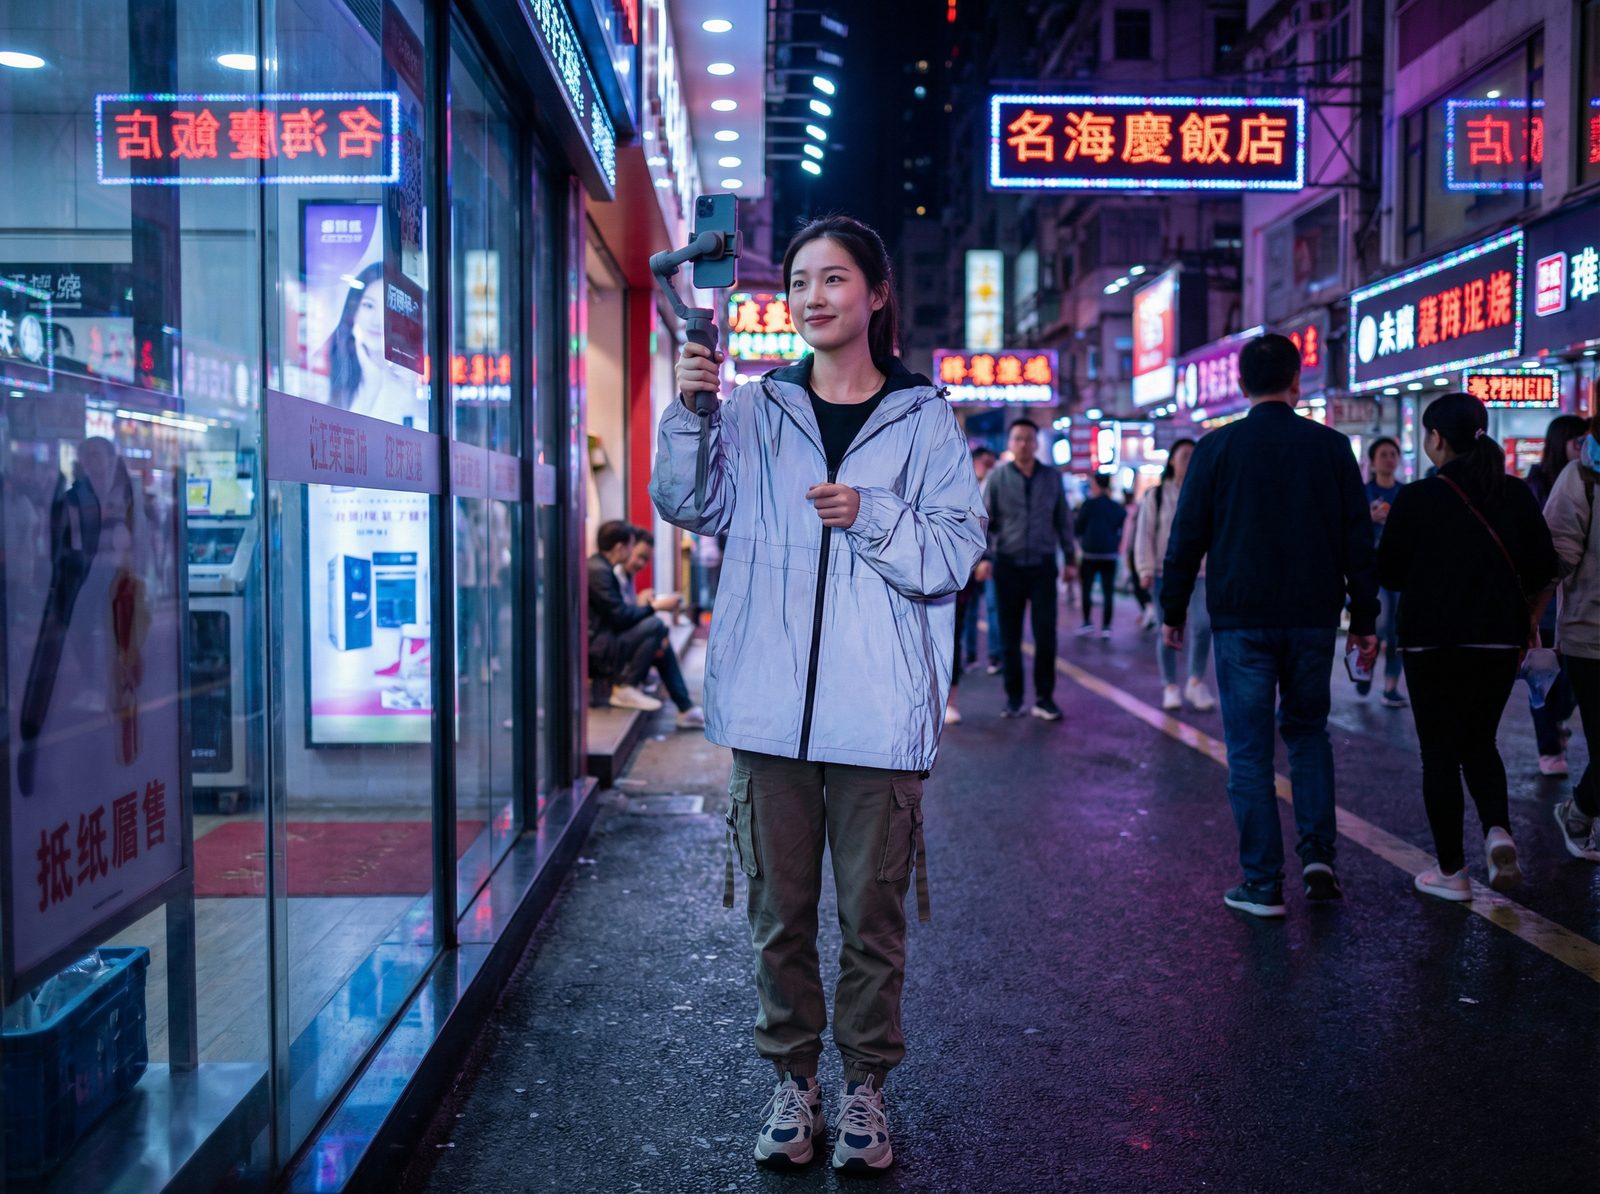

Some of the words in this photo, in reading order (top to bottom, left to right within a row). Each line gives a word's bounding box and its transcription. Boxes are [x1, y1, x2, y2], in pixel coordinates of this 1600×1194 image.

[1006, 109, 1288, 165] 名海慶飯店
